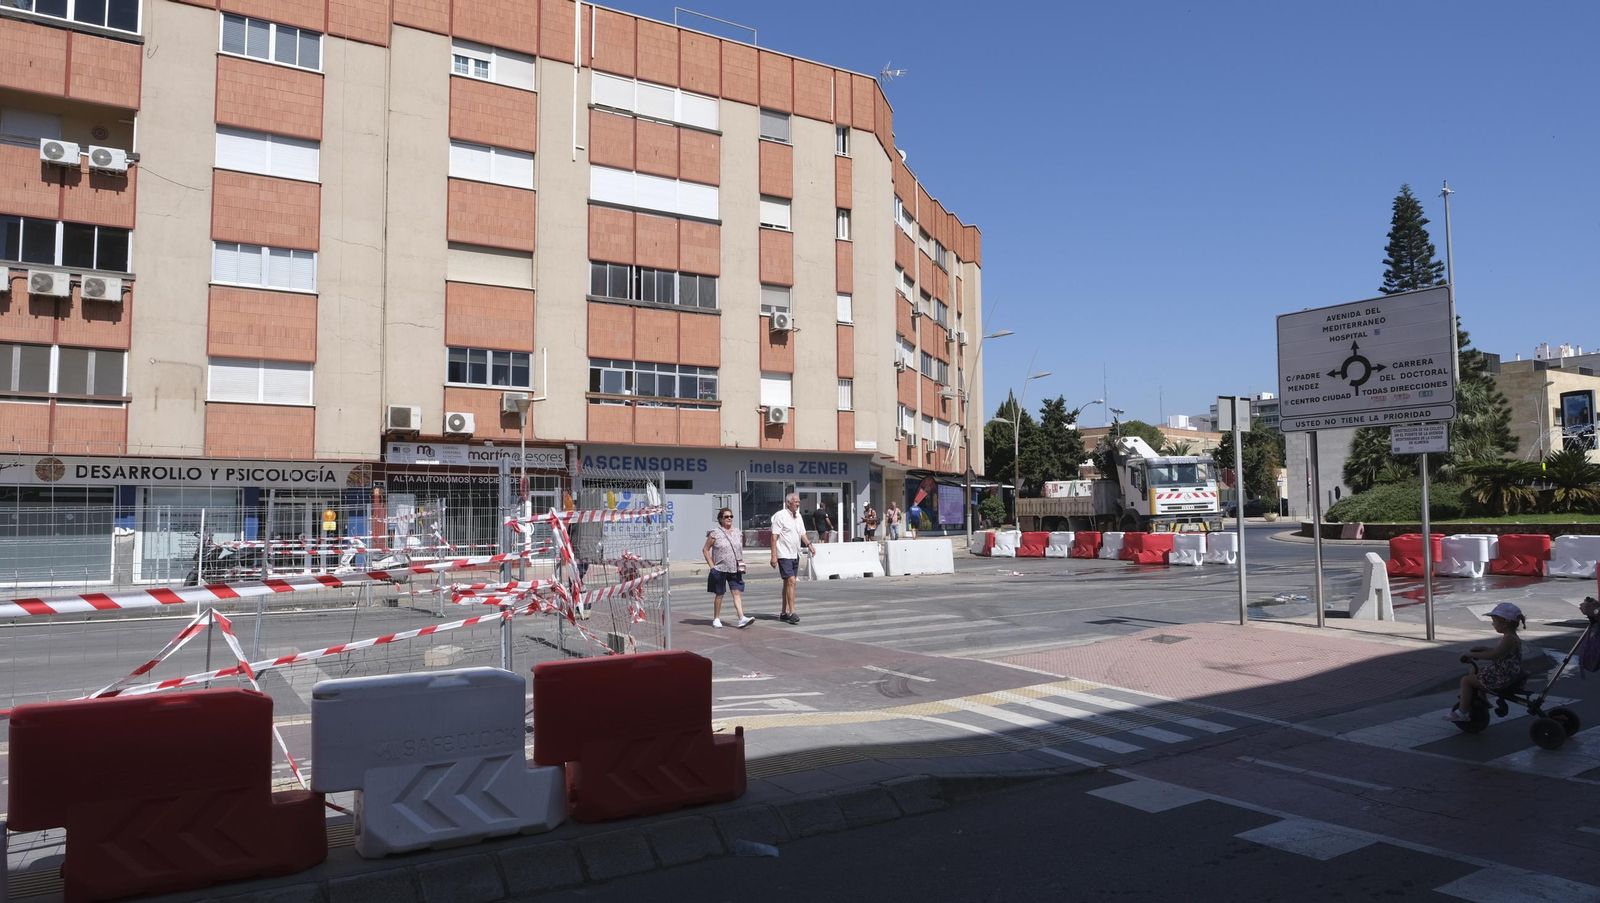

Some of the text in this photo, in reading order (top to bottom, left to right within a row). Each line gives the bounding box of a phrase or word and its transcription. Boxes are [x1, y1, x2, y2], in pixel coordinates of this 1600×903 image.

[1326, 307, 1381, 322] AVENIDA DEL
[1322, 317, 1386, 333] MEDITERRANEO
[1329, 332, 1368, 342] HOSPITAL
[1392, 358, 1434, 369] CARRERA
[1286, 372, 1321, 382] C/PADRE
[1379, 369, 1448, 382] DEL DOCTORAL
[1288, 383, 1319, 392] MENDEZ
[1362, 380, 1448, 396] TODAS DIRECCIONES
[1290, 393, 1352, 406] CENTRO CIUDAD
[1295, 419, 1321, 428] USTED
[1341, 415, 1365, 424] TIENE
[1383, 410, 1431, 421] PRIORIDAD
[582, 455, 708, 473] ASCENSORES
[749, 459, 848, 476] inelsa ZENER
[75, 464, 337, 483] DESARROLLO Y PSICOLOGÍA
[393, 475, 415, 483] ALTA
